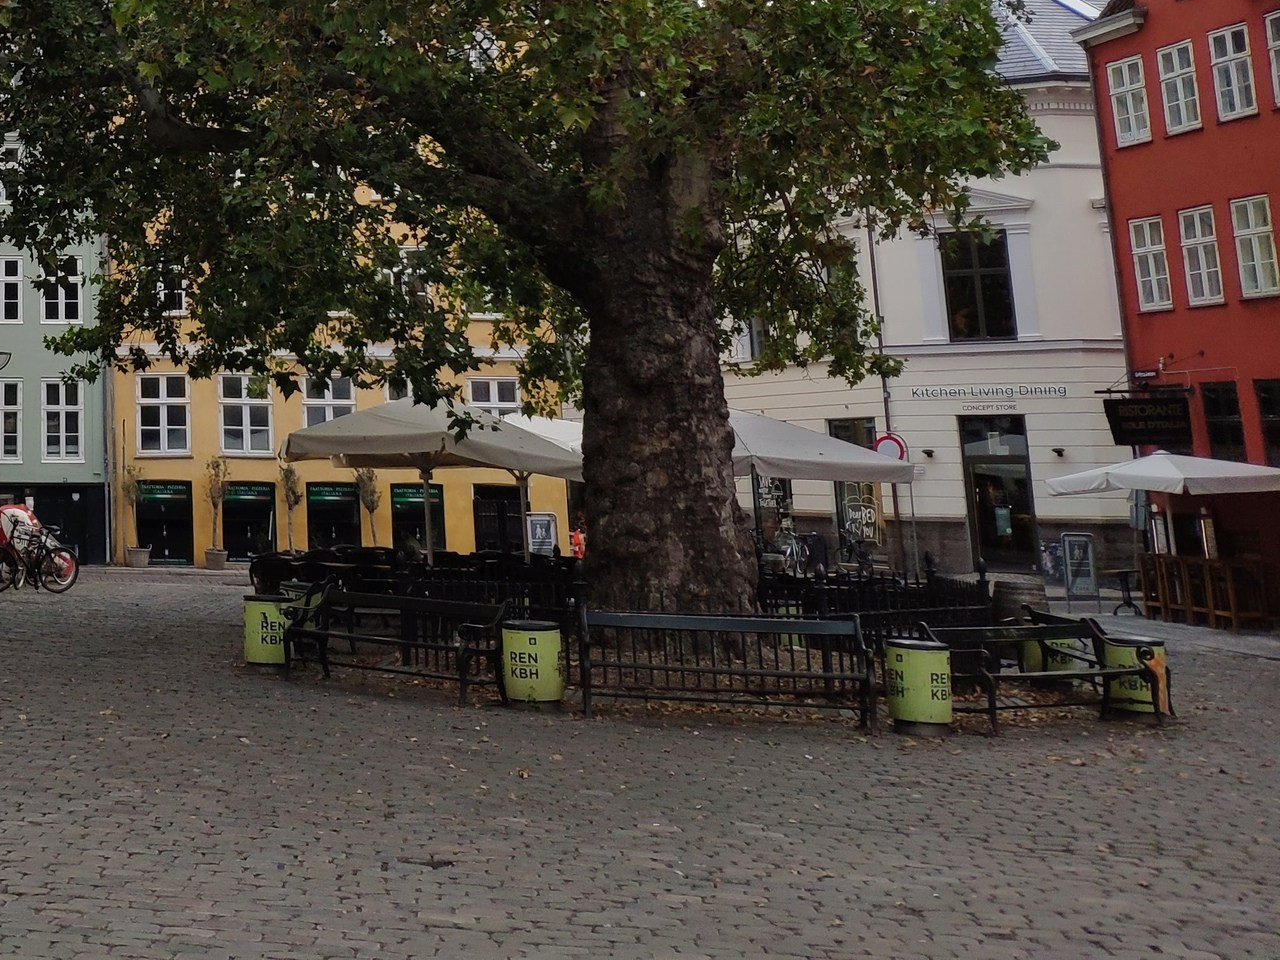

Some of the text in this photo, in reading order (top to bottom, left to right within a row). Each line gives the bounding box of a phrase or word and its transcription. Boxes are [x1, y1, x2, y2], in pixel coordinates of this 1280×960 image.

[912, 385, 1067, 398] Kitchen Living Dining
[1118, 404, 1184, 416] RISTORANTE
[861, 506, 876, 525] BED
[261, 621, 285, 631] REN
[510, 651, 538, 664] REN
[511, 667, 539, 679] KBH
[887, 669, 904, 681] EN
[889, 685, 905, 698] BH
